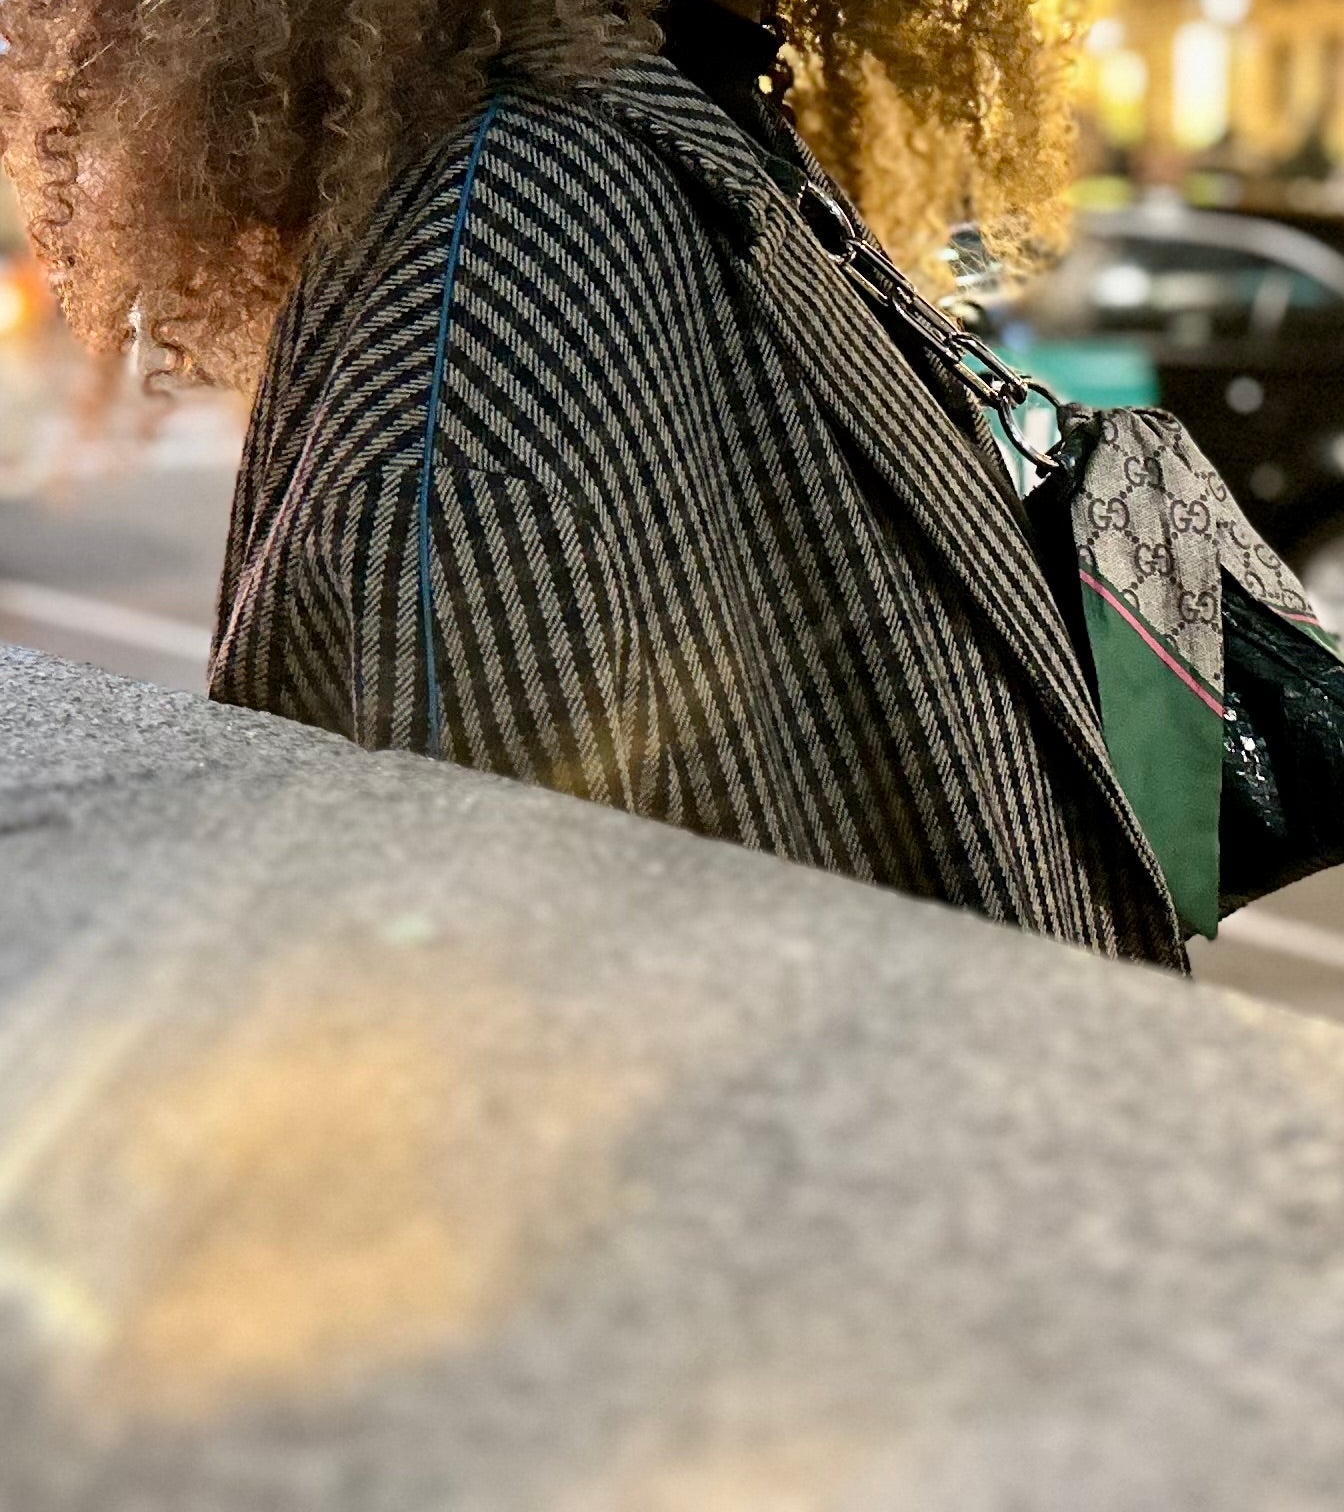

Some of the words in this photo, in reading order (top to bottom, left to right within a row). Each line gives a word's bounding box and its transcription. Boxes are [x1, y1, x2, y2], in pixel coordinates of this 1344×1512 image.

[1088, 497, 1130, 532] GG
[1170, 499, 1210, 534] GG
[1135, 543, 1174, 576] GG
[1179, 590, 1217, 624] GG
